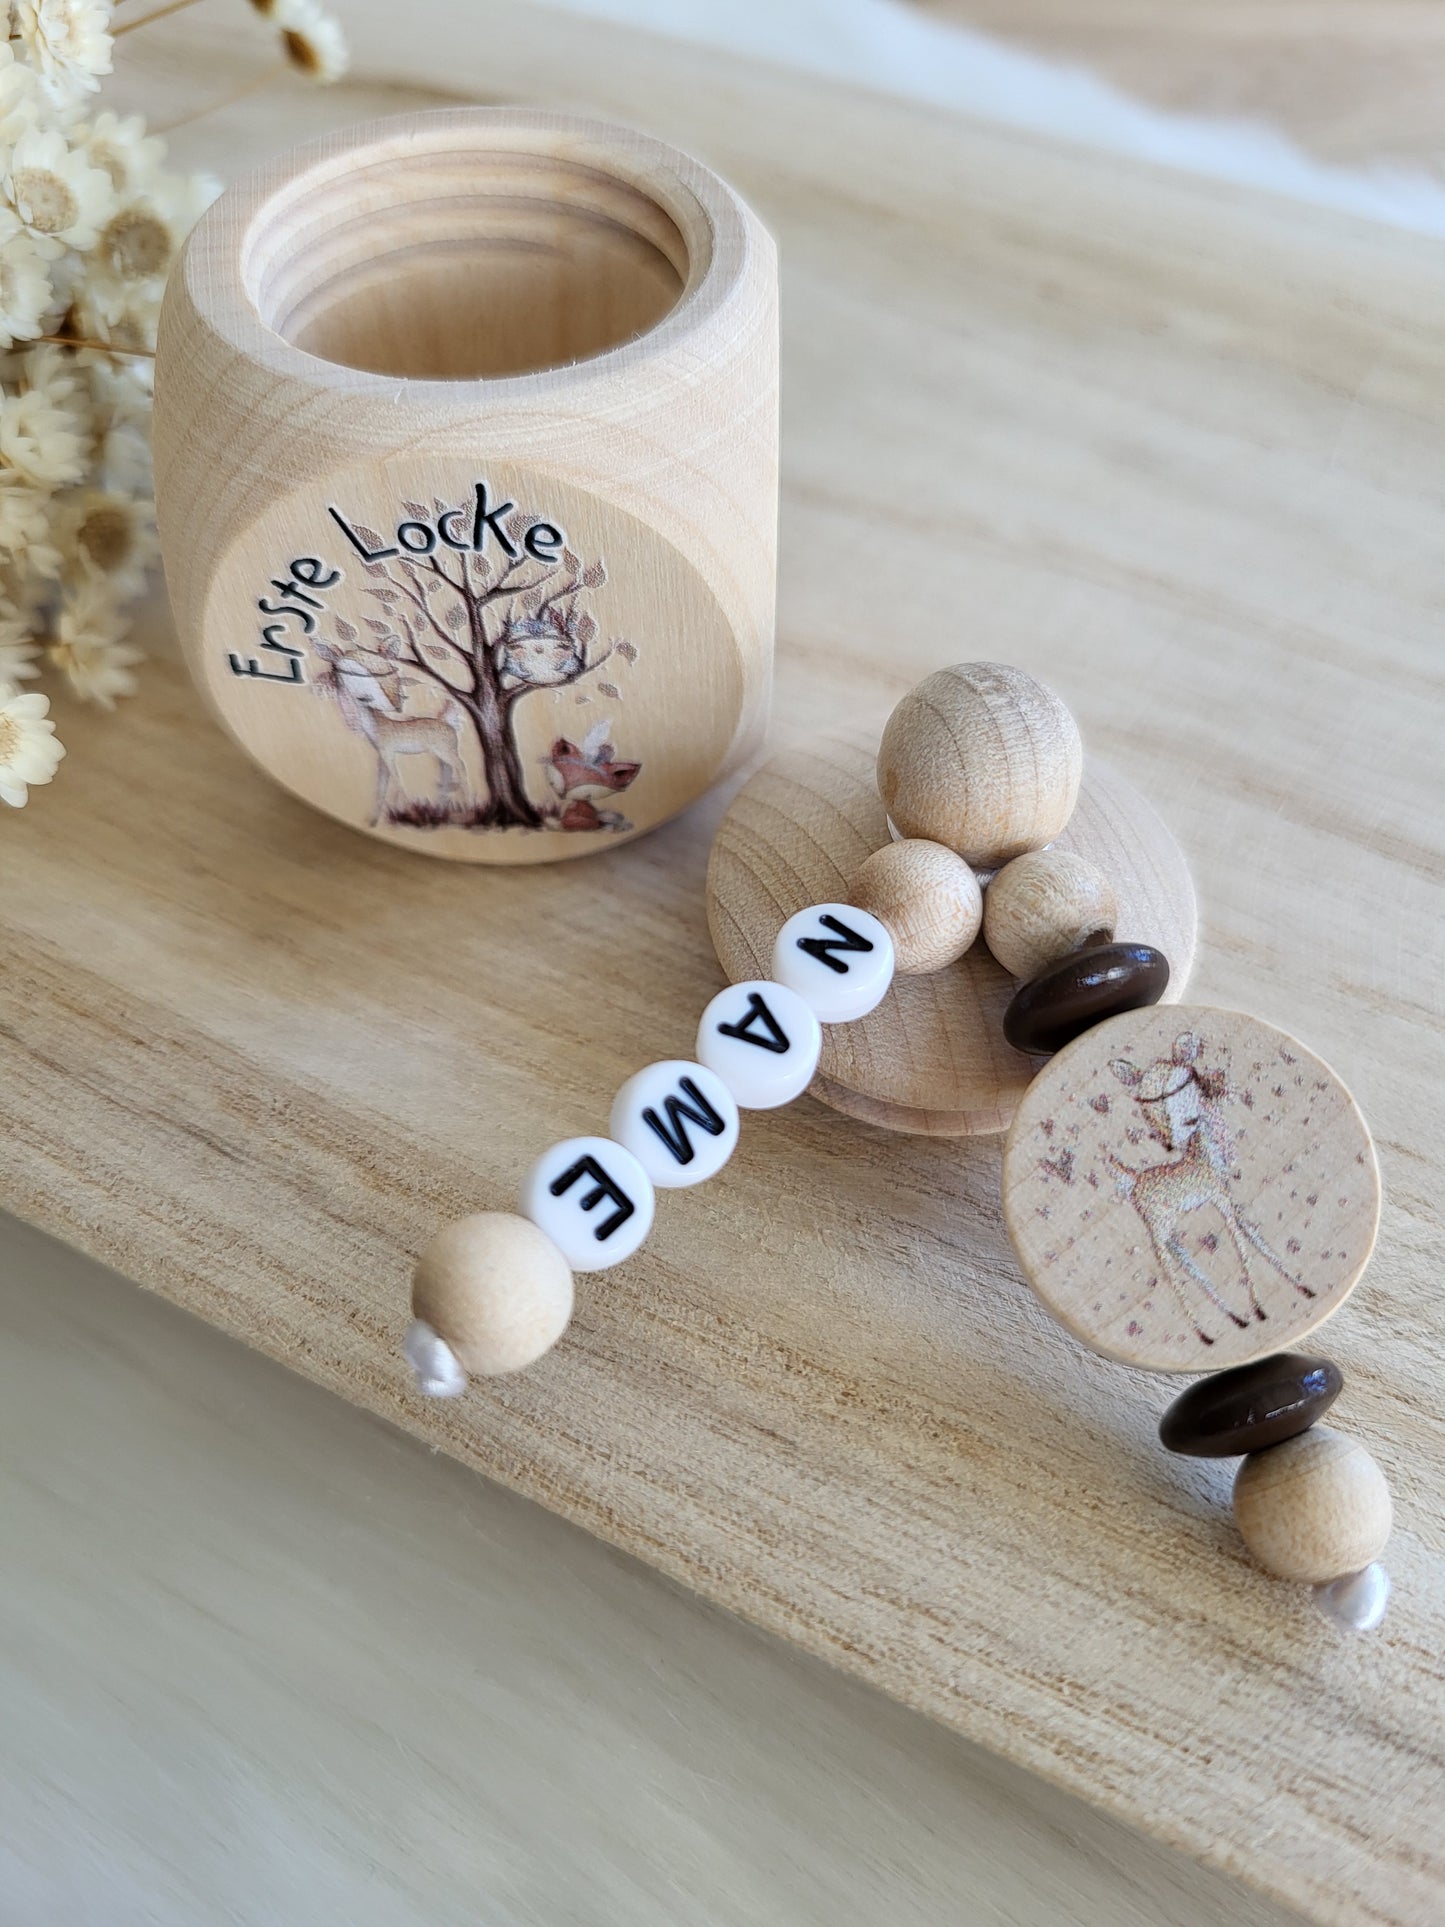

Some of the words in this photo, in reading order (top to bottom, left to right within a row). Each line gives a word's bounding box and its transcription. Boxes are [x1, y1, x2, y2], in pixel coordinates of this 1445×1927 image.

[229, 556, 342, 685] Erste
[327, 482, 564, 564] Locke
[549, 913, 875, 1242] NAME
